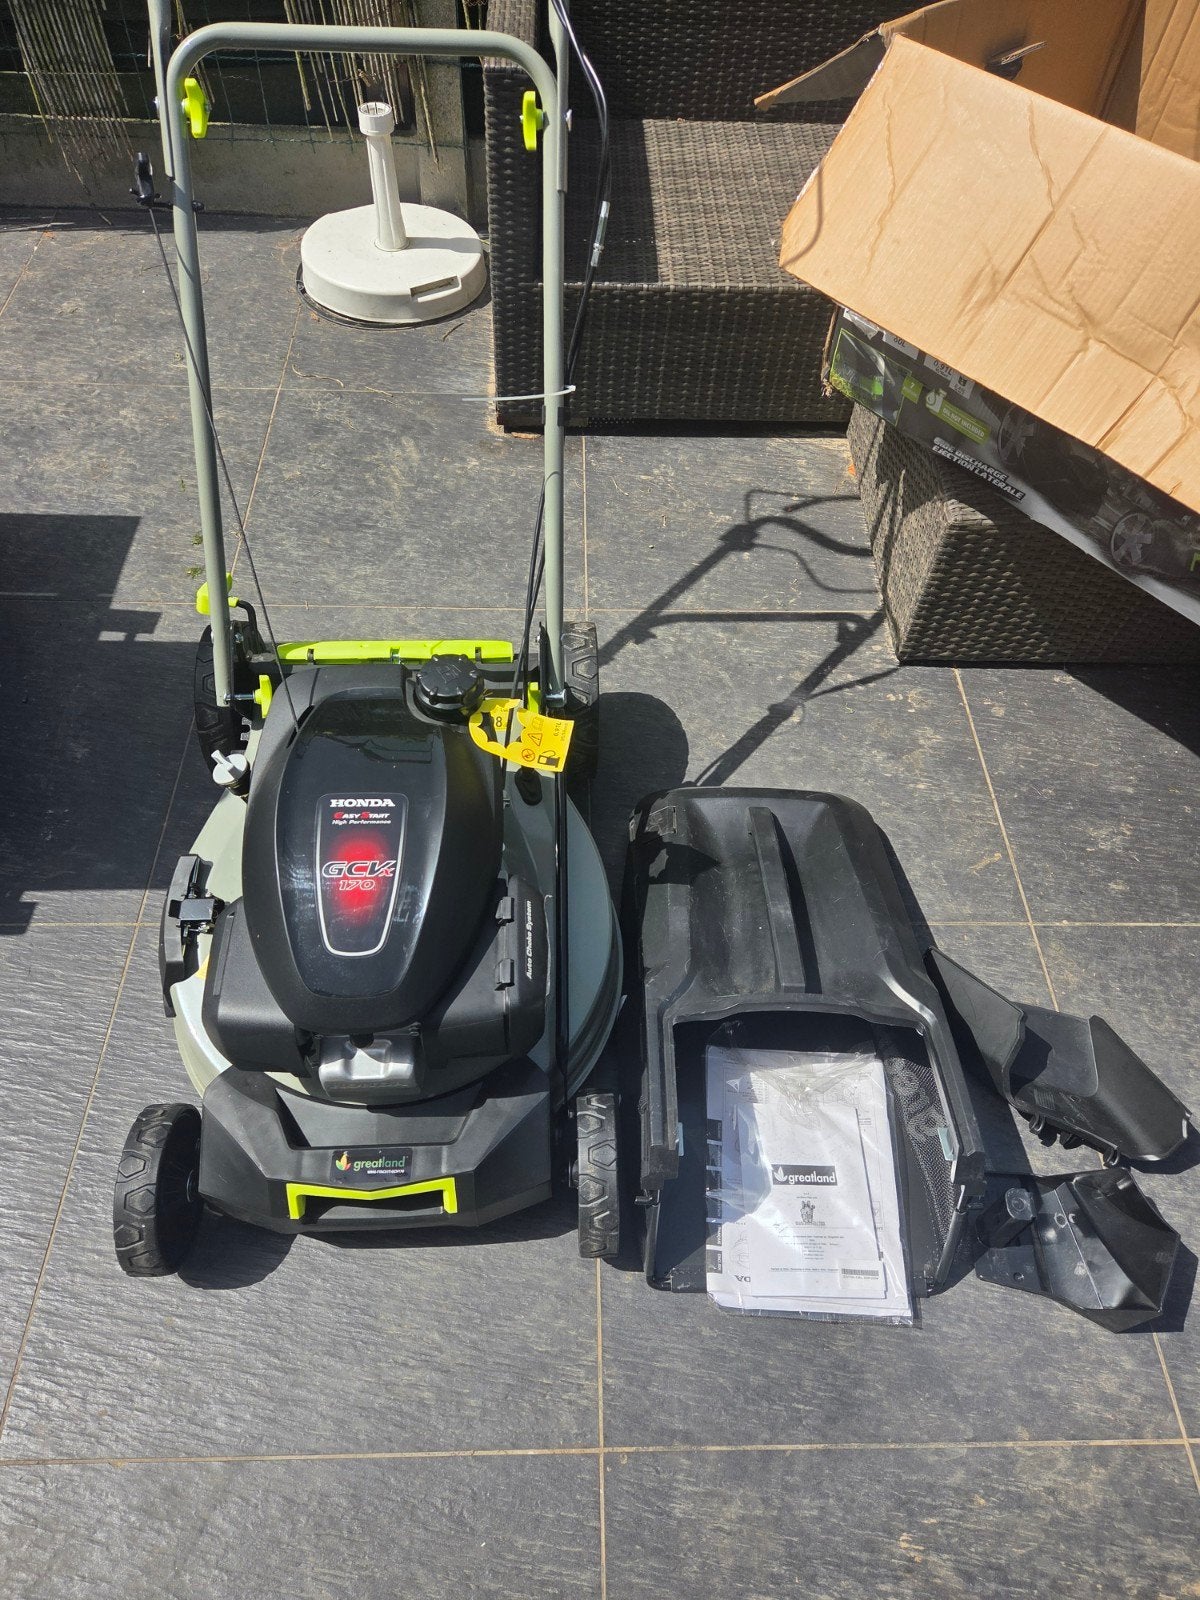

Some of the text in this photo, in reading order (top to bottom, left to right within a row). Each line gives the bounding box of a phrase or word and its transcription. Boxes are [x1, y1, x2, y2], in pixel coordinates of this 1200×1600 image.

[932, 445, 1025, 499] EJECTION LATERALE
[955, 449, 1008, 481] DISCHARGE
[329, 798, 396, 808] HONDA
[339, 879, 376, 891] 170
[525, 900, 534, 931] System
[353, 1156, 406, 1171] greatland
[788, 1170, 836, 1185] greatland
[734, 1274, 751, 1283] DA
